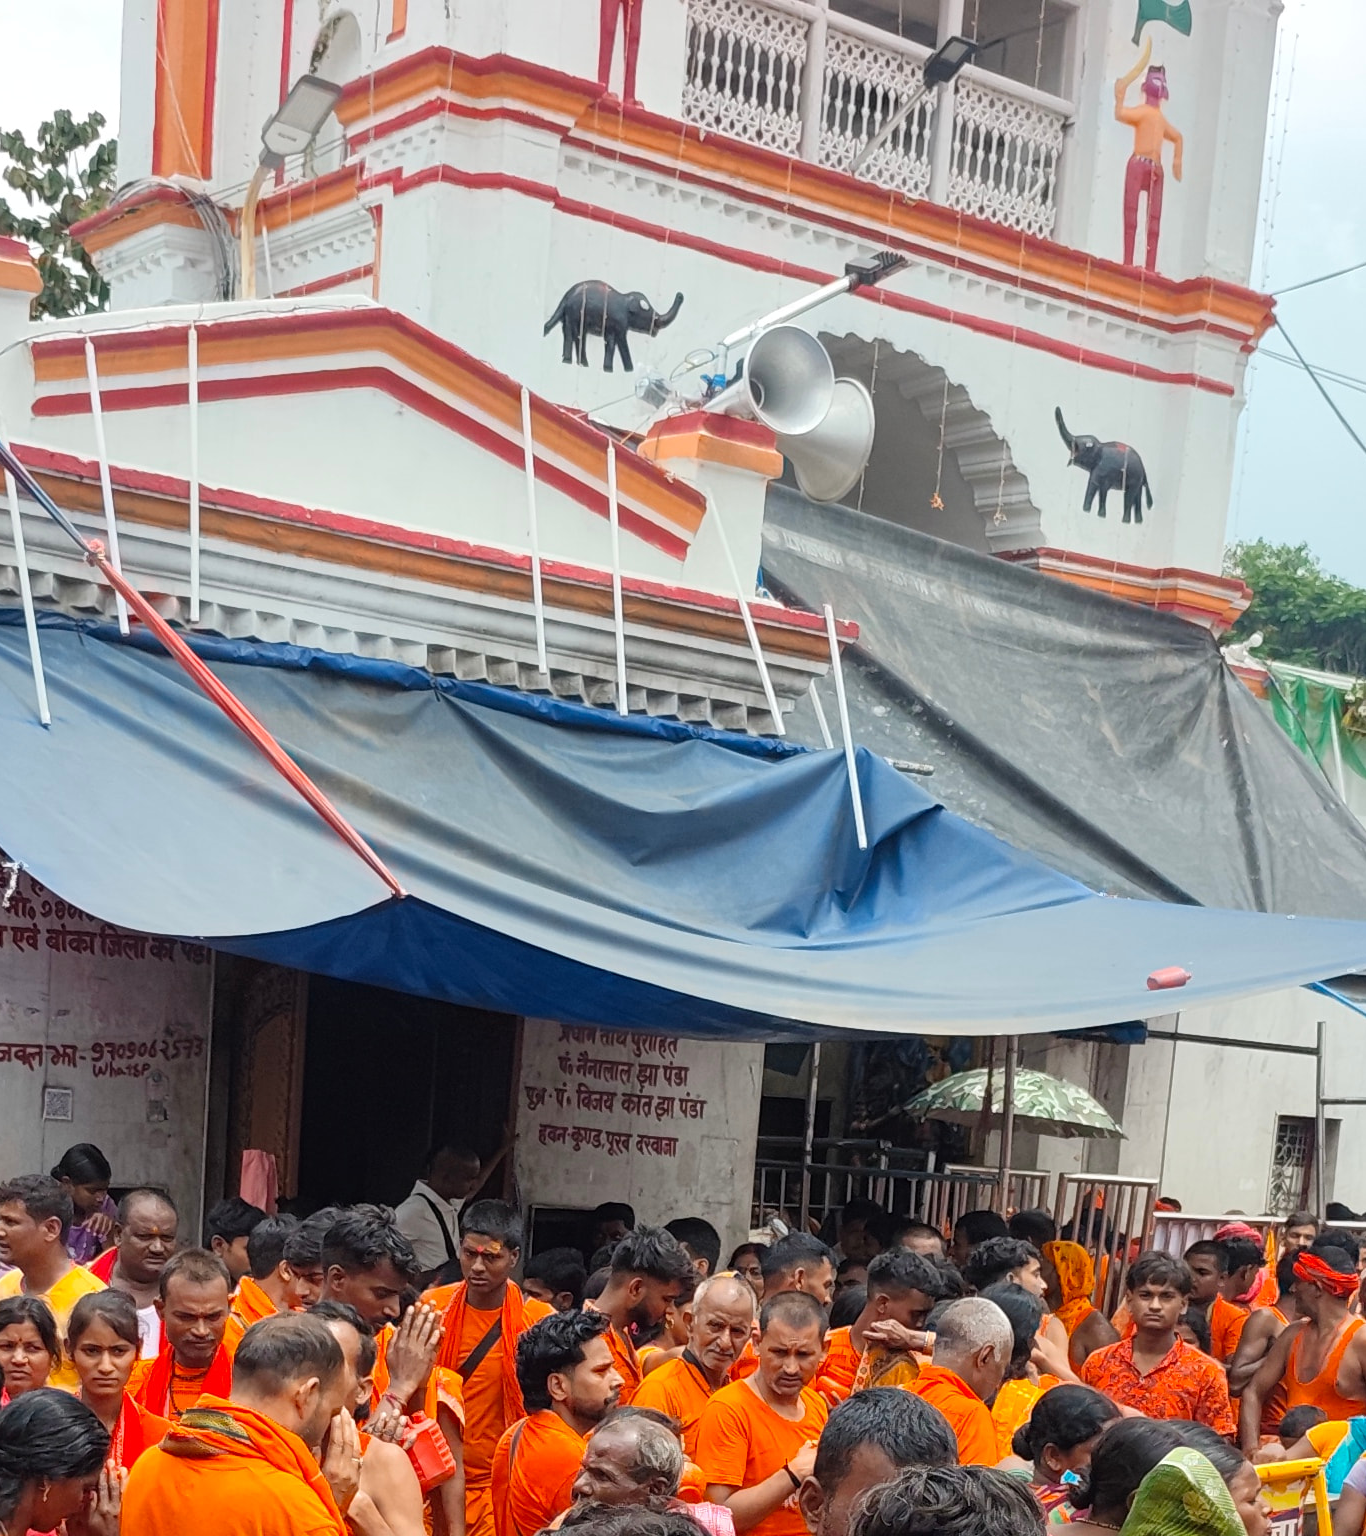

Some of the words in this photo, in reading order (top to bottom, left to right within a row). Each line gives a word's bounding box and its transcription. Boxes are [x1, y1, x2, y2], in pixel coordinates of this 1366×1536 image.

[99, 925, 149, 961] जिला
[576, 1051, 635, 1083] नैनालाल
[636, 1063, 660, 1089] झा
[663, 1061, 690, 1087] पंडा
[576, 1083, 617, 1114] विजय
[655, 1095, 676, 1122] झा
[679, 1092, 707, 1120] पंडा
[636, 1134, 679, 1157] दरवाजा
